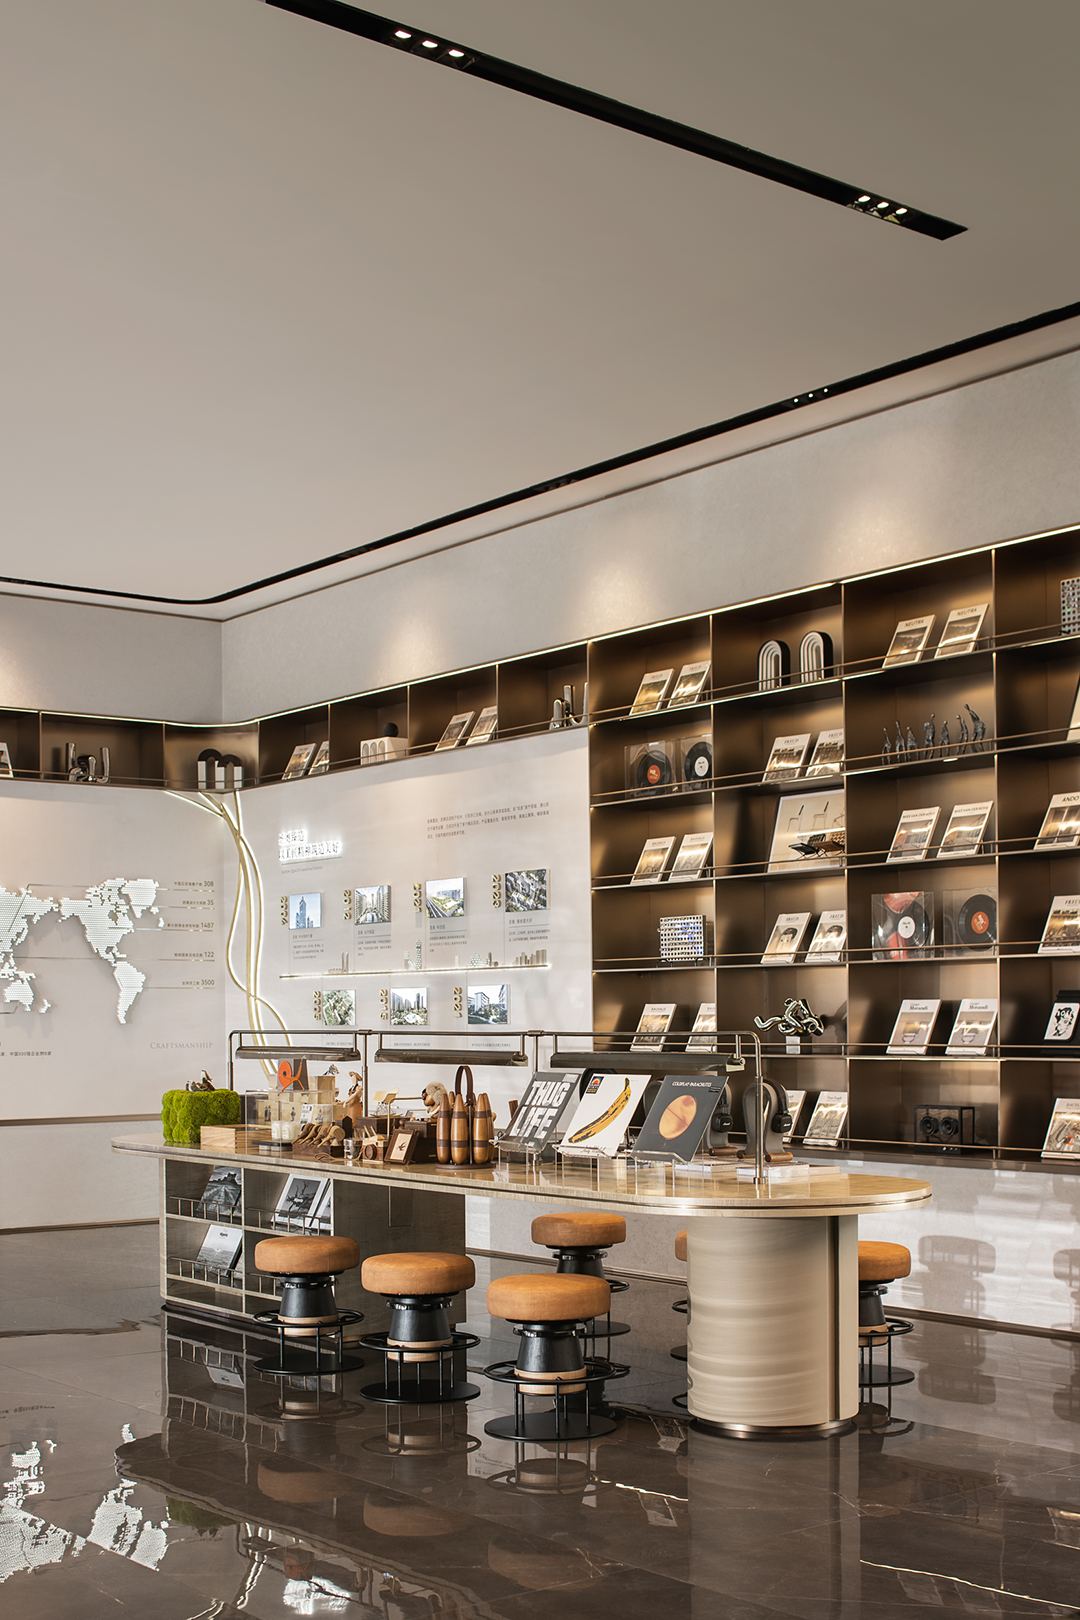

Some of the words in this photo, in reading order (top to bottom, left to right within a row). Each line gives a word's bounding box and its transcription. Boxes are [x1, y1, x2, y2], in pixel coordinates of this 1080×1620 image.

[150, 1041, 213, 1049] CRAFTSMANSHIP
[525, 1081, 570, 1107] THUG
[509, 1106, 558, 1139] LIFE
